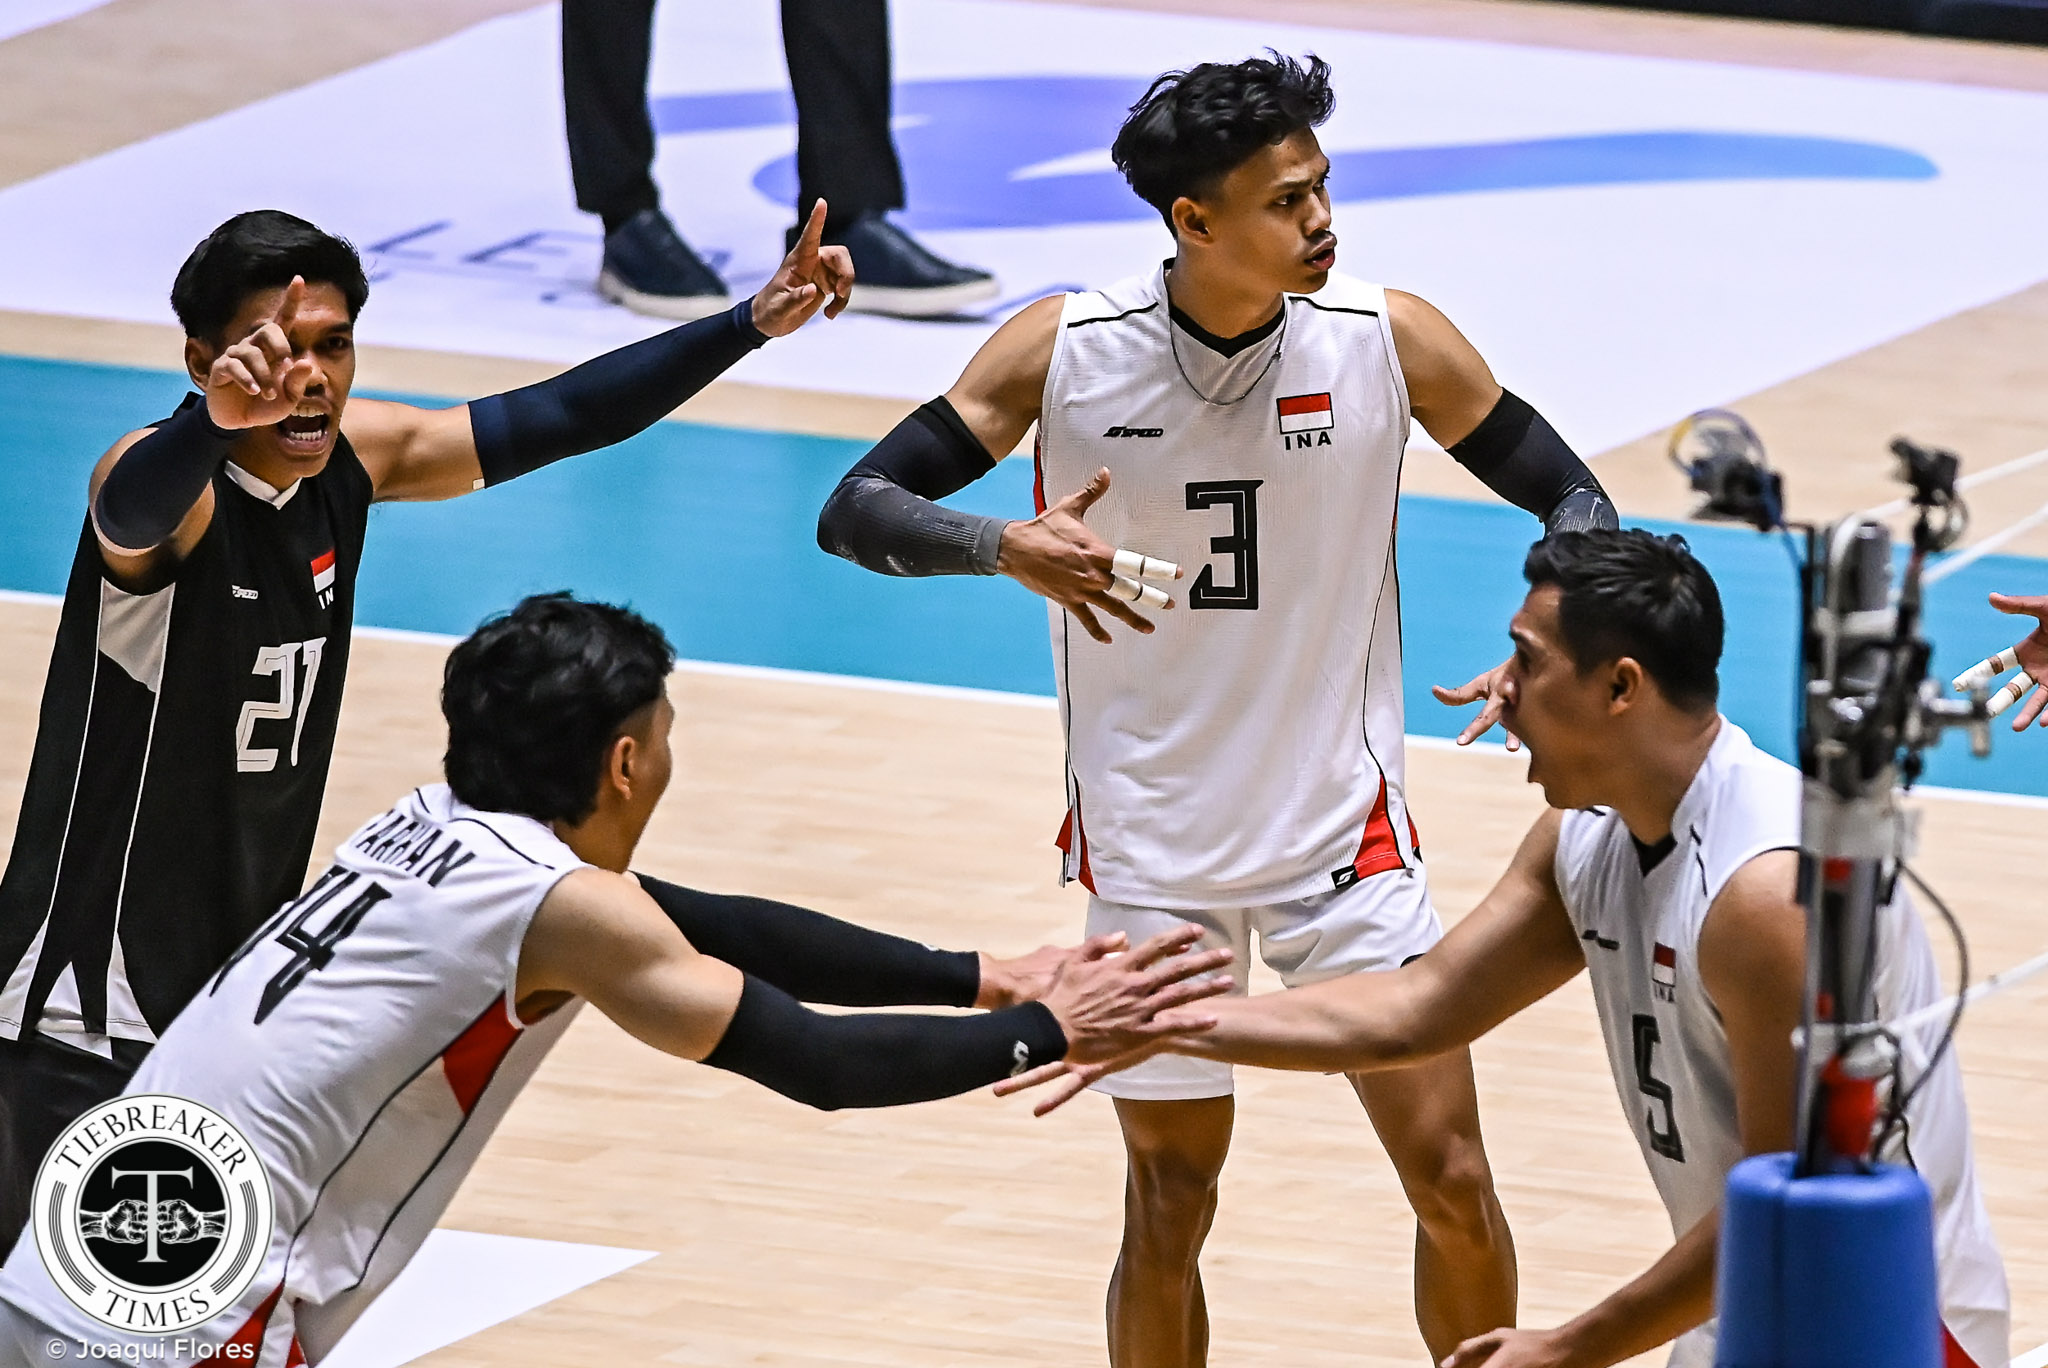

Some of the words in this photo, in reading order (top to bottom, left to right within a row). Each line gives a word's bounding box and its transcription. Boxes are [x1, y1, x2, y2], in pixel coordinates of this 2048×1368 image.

[1284, 432, 1332, 450] INA
[318, 587, 335, 610] IN
[1185, 479, 1265, 610] 3
[235, 636, 328, 773] 21
[209, 864, 393, 1025] 14
[1632, 1013, 1686, 1164] 5
